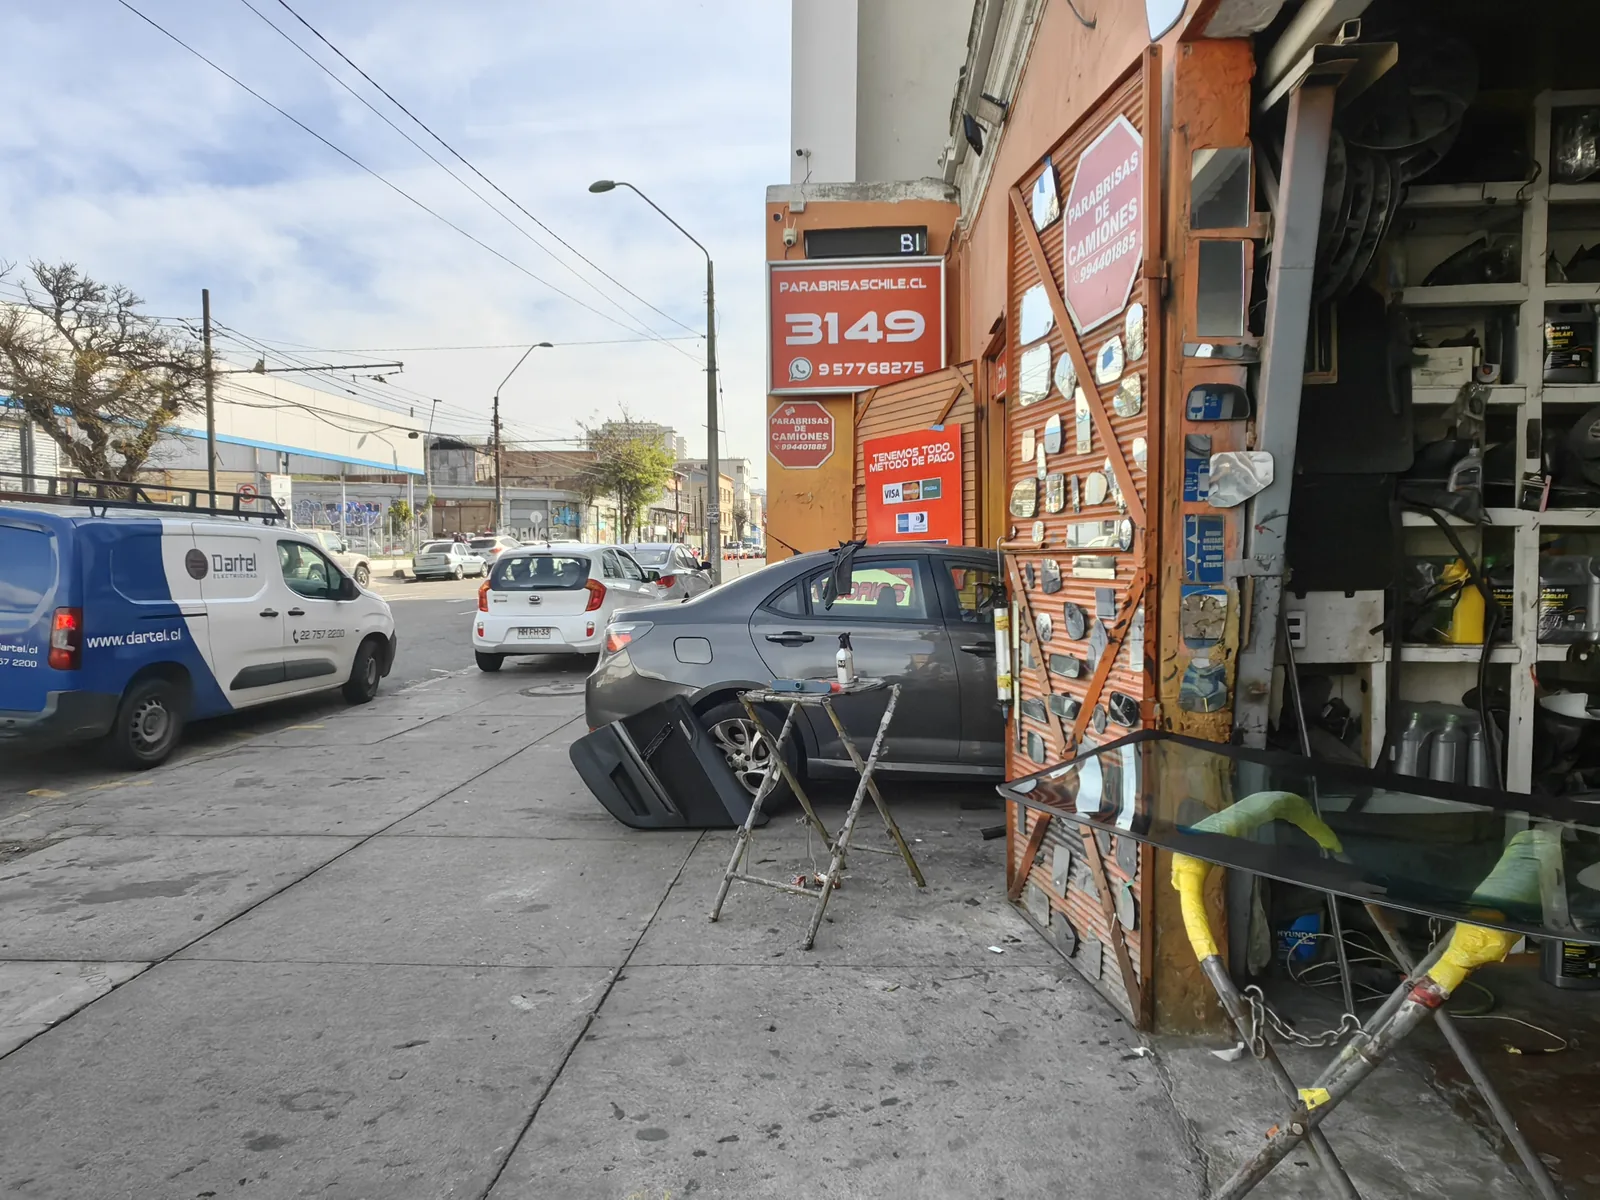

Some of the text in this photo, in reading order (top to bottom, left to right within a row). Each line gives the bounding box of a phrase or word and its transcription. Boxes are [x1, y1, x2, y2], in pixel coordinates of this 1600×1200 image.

[1068, 150, 1139, 226] PARABRISAS
[1095, 198, 1110, 224] DE
[1068, 197, 1138, 267] CAMIONES
[1080, 229, 1137, 284] 994401885
[779, 277, 927, 293] PARABRISASCHILE.CL
[785, 309, 926, 346] 3149
[771, 417, 829, 425] PARABRISAS
[772, 432, 829, 441] CAMIONES
[869, 452, 955, 473] METODO DE PAGO
[872, 442, 950, 463] TENEMOS TODO
[884, 488, 900, 499] VISA
[211, 552, 257, 572] Dartel
[86, 628, 181, 648] www.dartel.cl
[300, 630, 310, 640] 22
[12, 658, 37, 668] 2200
